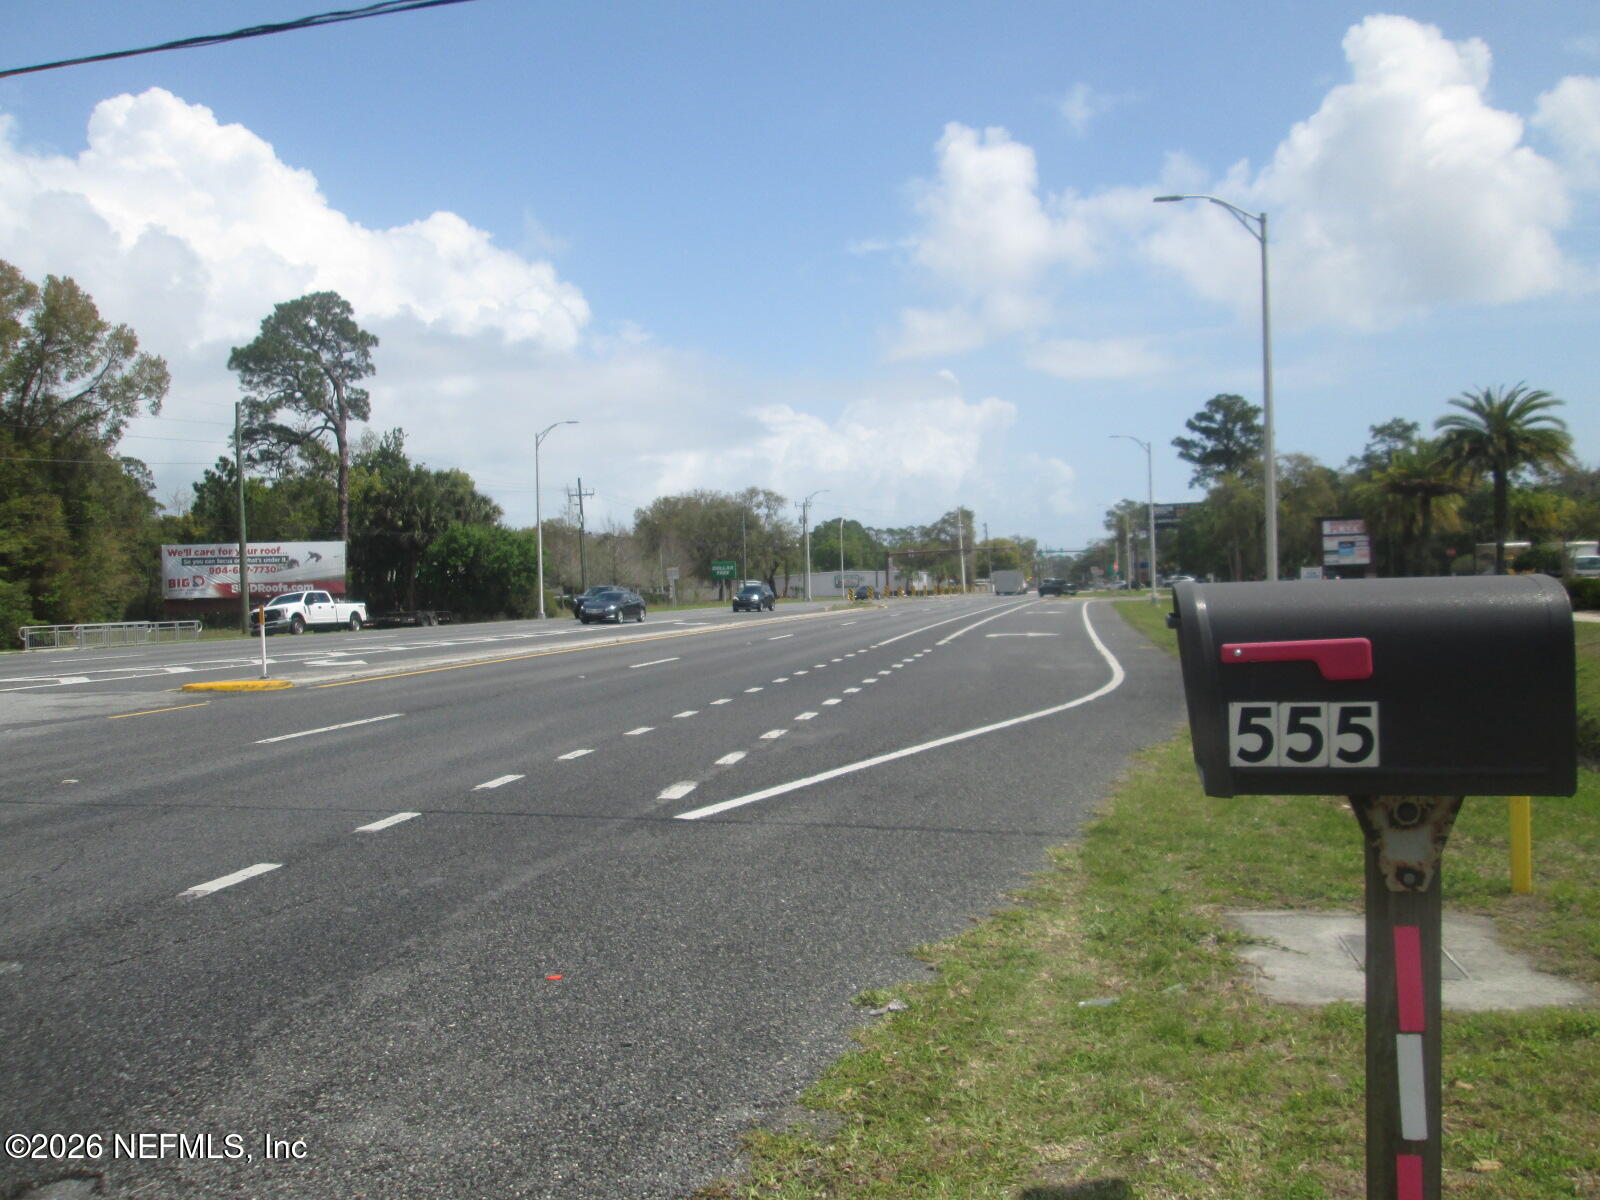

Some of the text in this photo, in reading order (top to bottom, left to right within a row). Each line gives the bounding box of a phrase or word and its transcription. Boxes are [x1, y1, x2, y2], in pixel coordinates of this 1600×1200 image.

[168, 548, 192, 557] We'll
[194, 548, 216, 556] care
[218, 547, 233, 556] for
[234, 548, 258, 557] yur
[208, 565, 277, 575] 904-67-7730
[168, 578, 190, 588] BIG
[231, 583, 314, 594] BiDRoofs.com
[1237, 706, 1374, 763] 555
